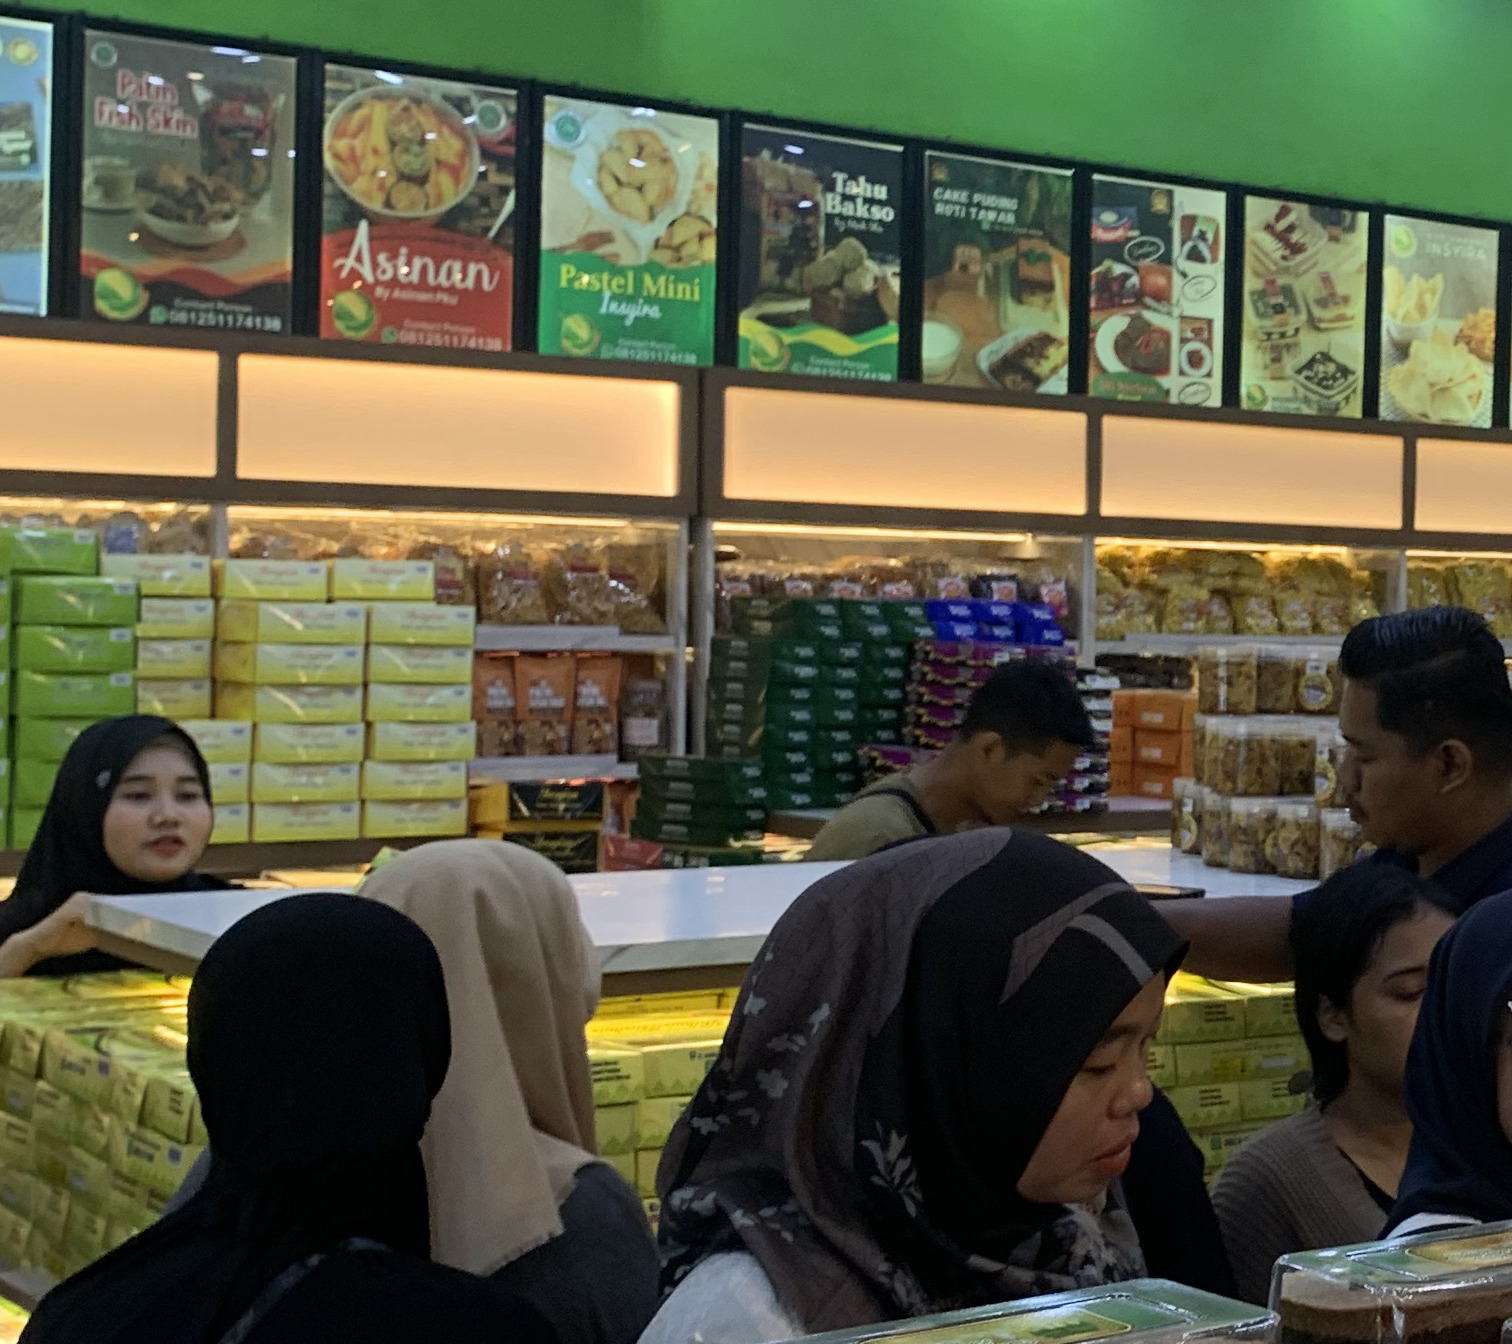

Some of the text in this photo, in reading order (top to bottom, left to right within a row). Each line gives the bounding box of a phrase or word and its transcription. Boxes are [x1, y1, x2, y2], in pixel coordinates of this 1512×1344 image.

[147, 105, 199, 139] Skin
[831, 171, 888, 201] Tahu
[825, 191, 896, 223] Bakso
[333, 218, 500, 292] Asinan
[559, 262, 700, 302] Pastel Mini
